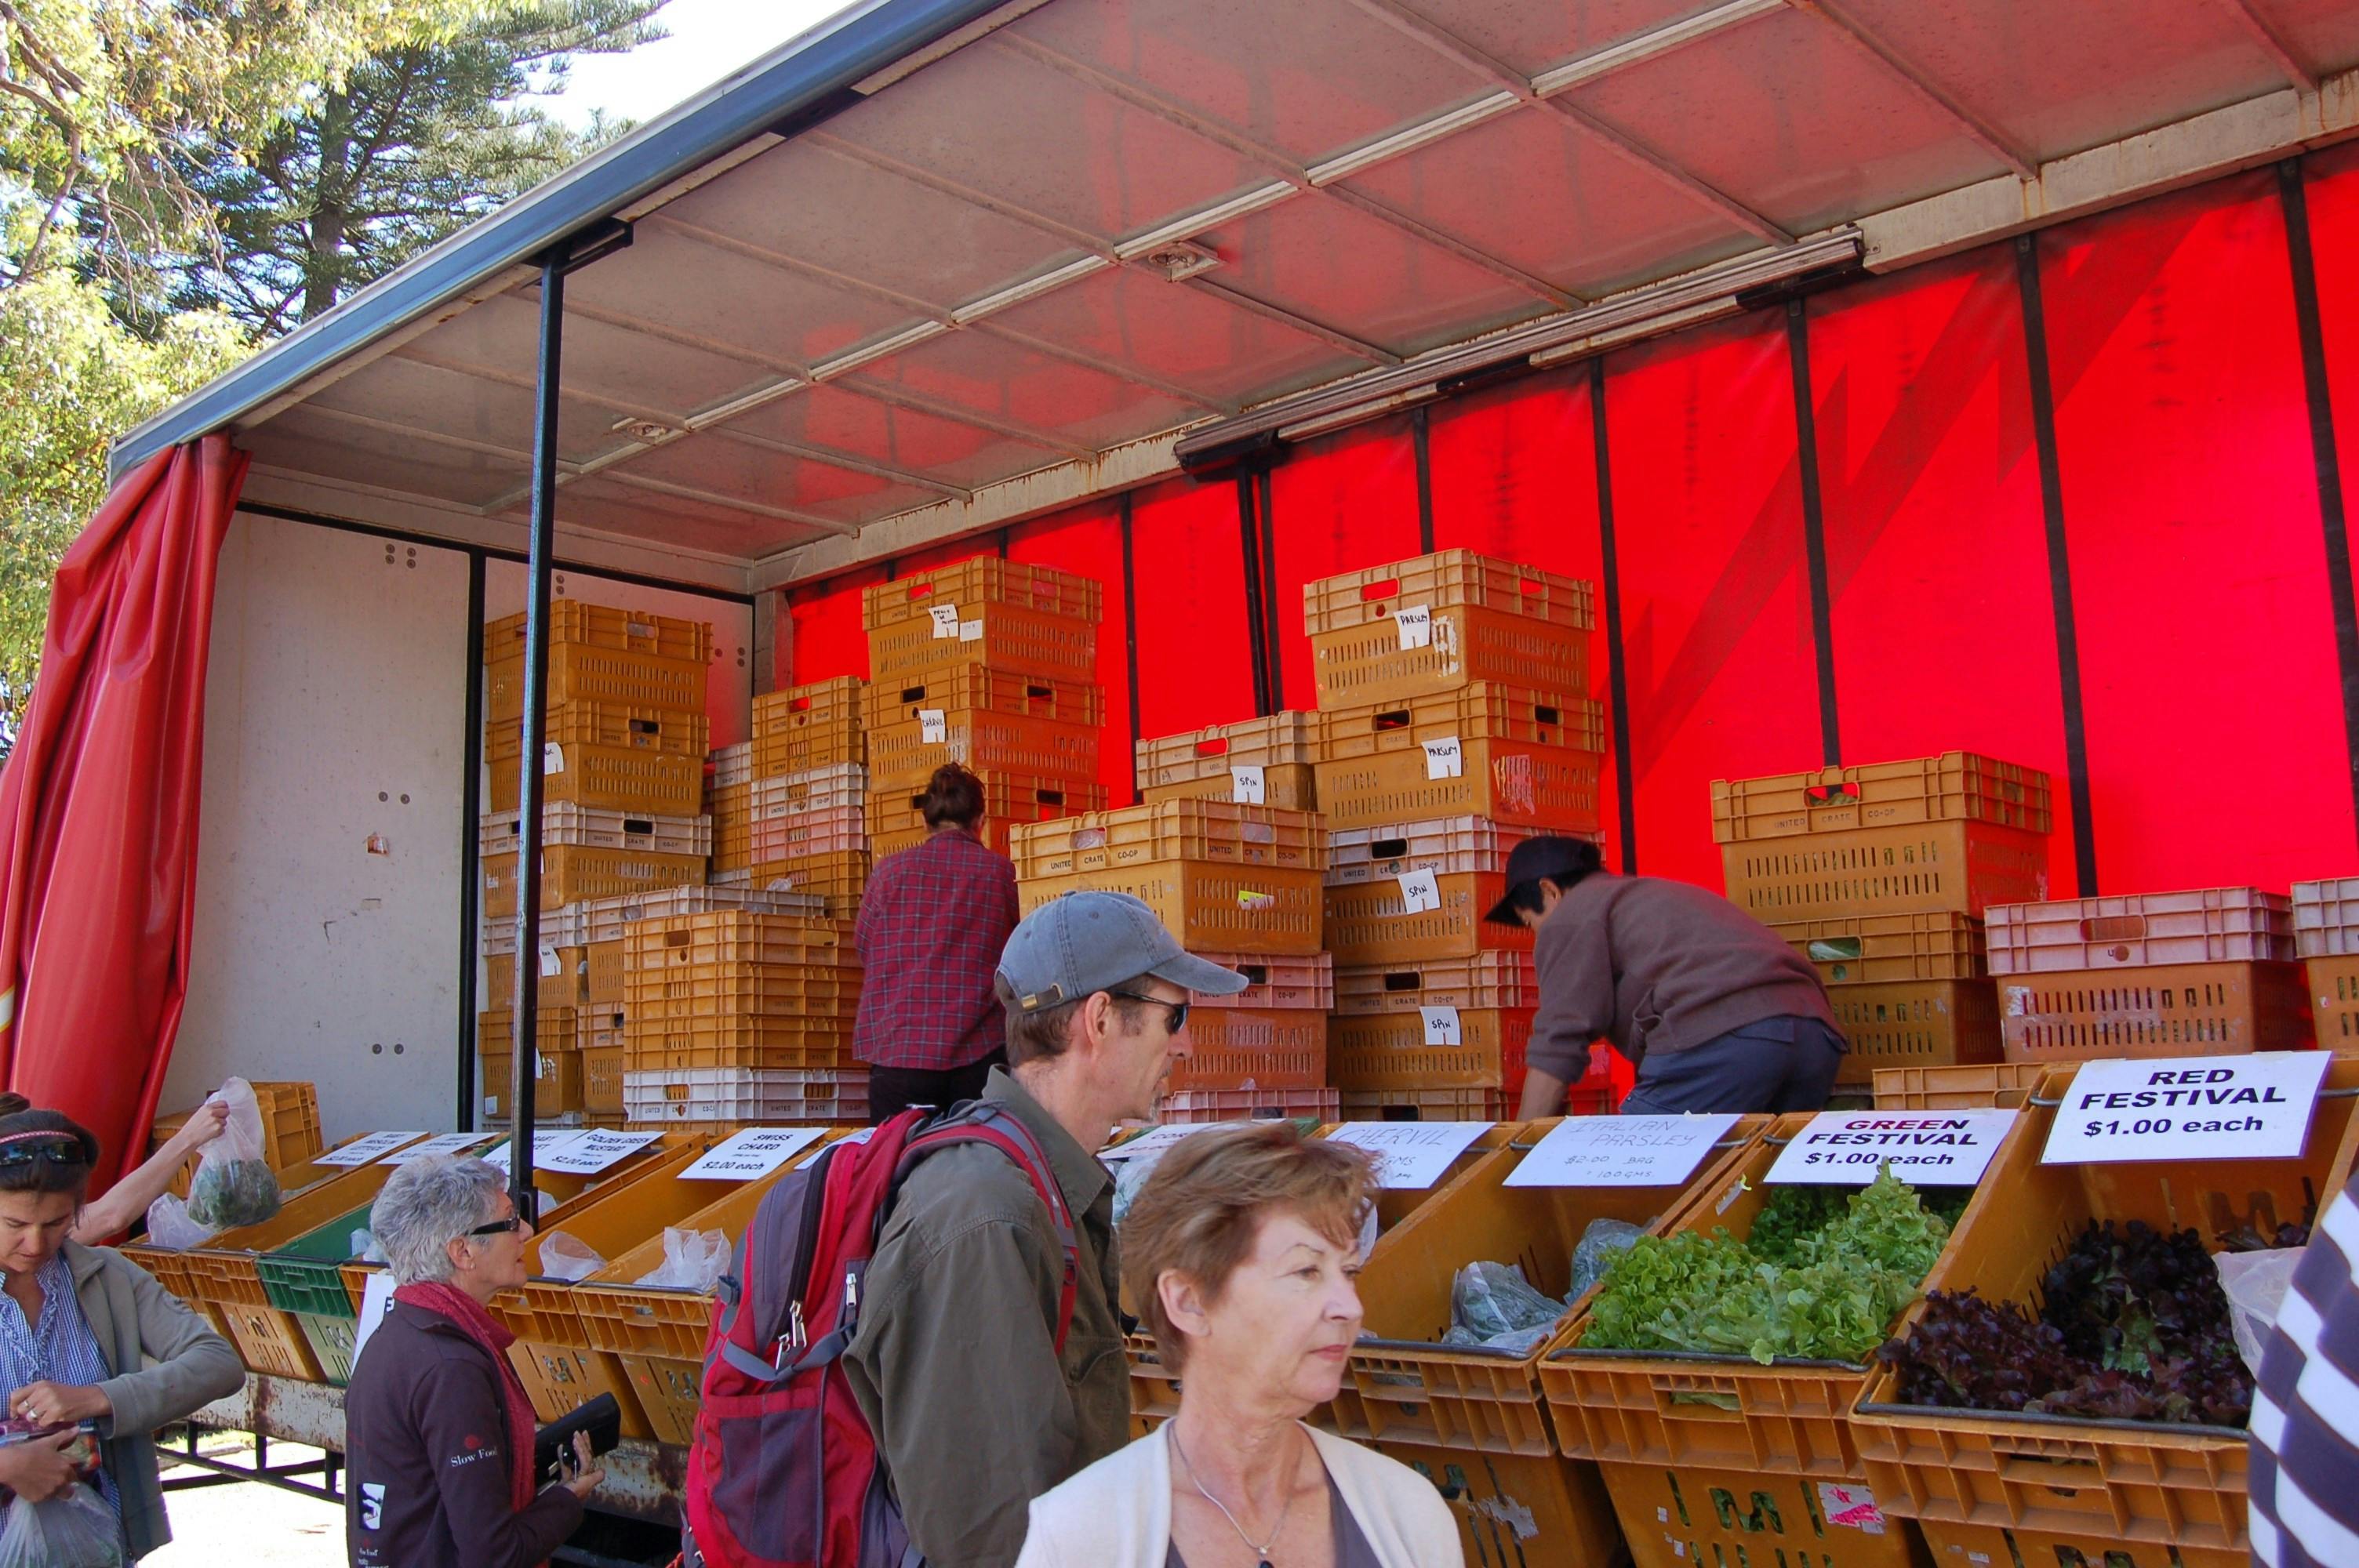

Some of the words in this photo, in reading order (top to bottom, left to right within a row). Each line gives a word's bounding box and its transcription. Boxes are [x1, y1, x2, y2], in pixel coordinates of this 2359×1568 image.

[1400, 613, 1428, 625] PARSLEY
[1427, 745, 1459, 757] PARSLEY
[1239, 776, 1257, 787] SPIN
[1774, 817, 1805, 829] UNITED
[1821, 812, 1852, 823] CRATE
[1867, 808, 1896, 818] CO-OP
[1209, 845, 1233, 855] UNITED
[1084, 854, 1104, 864] CRATE
[1118, 849, 1139, 859] CO-OP
[1343, 869, 1365, 878] UNITED
[1408, 884, 1427, 898] SPIN
[1278, 990, 1296, 999] CO-OP
[1431, 1018, 1452, 1029] SPIN
[2147, 1069, 2234, 1086] RED
[2080, 1087, 2287, 1110] FESTIVAL
[1570, 1120, 1680, 1134] ITALIAN
[1845, 1120, 1970, 1131] GREEN
[2084, 1119, 2172, 1138] $1.00
[2183, 1116, 2263, 1133] each
[587, 1134, 621, 1144] GOLDEN
[753, 1133, 794, 1142] SWISS
[1336, 1127, 1450, 1146] CHERVIL
[1589, 1134, 1698, 1147] PARSLEY
[1806, 1134, 1979, 1145] FESTIVAL
[551, 1155, 581, 1166] $2.00
[1623, 1156, 1656, 1165] BAG
[1805, 1152, 1879, 1165] $1.00
[1887, 1153, 1954, 1165] each
[702, 1160, 734, 1170] $2.00
[735, 1162, 765, 1171] each
[450, 1454, 477, 1468] Slow
